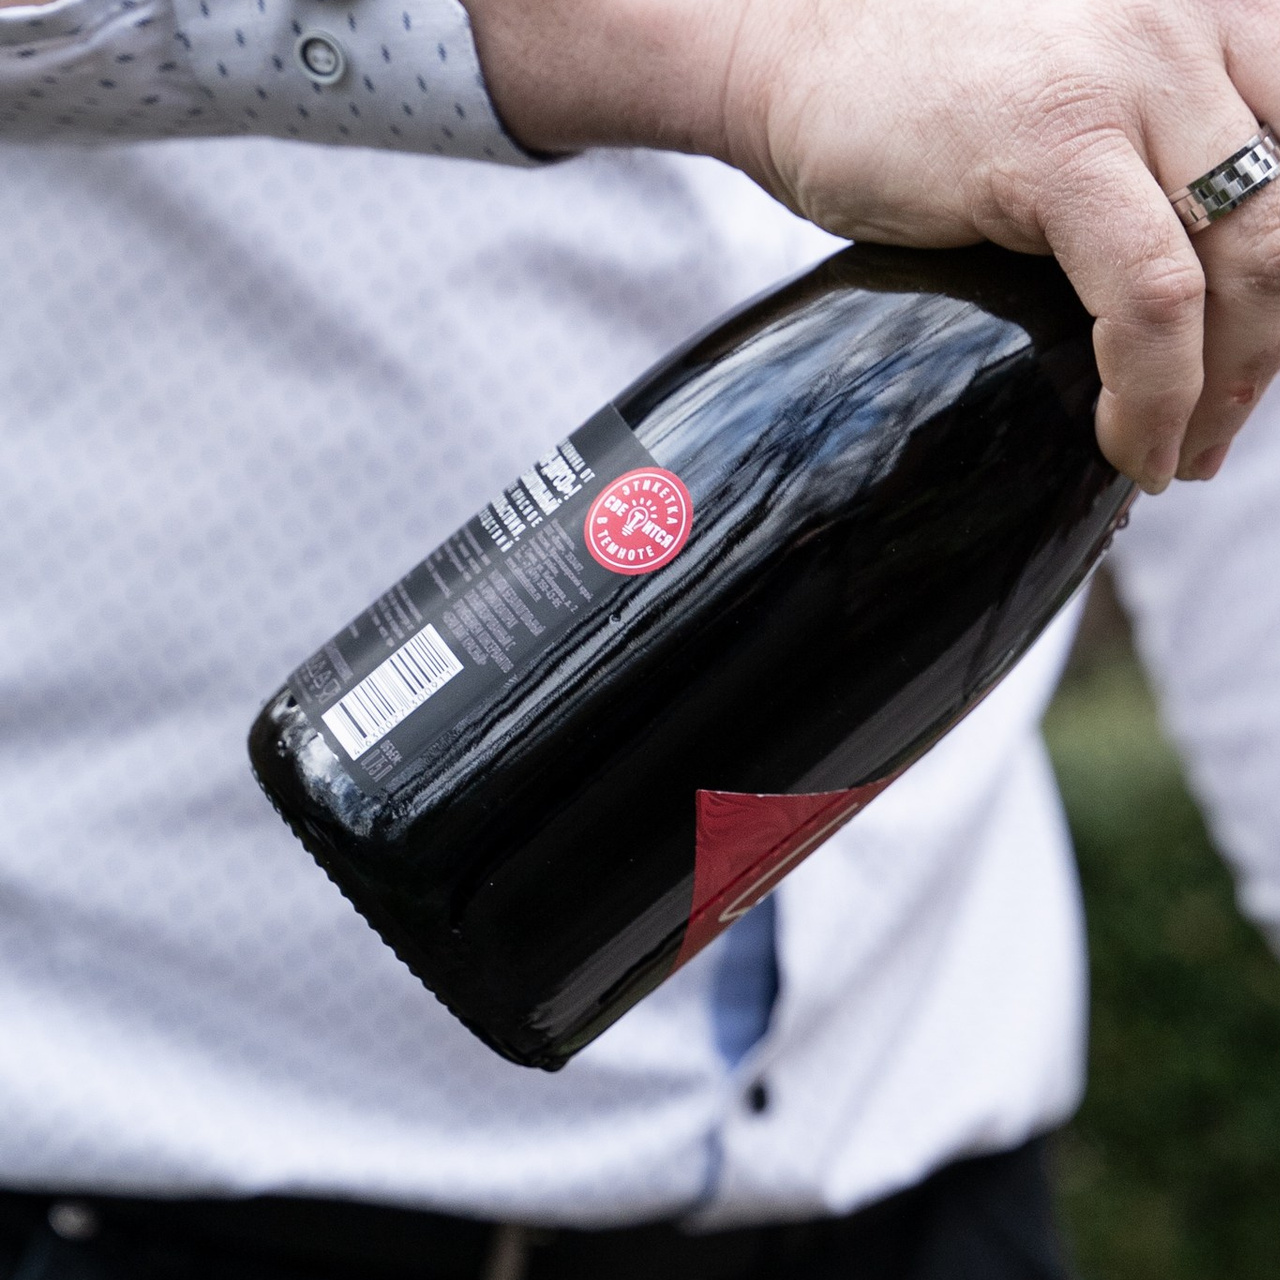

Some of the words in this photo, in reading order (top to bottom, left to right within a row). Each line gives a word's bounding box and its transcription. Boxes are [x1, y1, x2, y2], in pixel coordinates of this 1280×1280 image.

[603, 495, 674, 549] СВЕТИТСЯ
[621, 479, 679, 525] ЭТИКЕТКА
[597, 529, 655, 561] ТЕМНОТЕ
